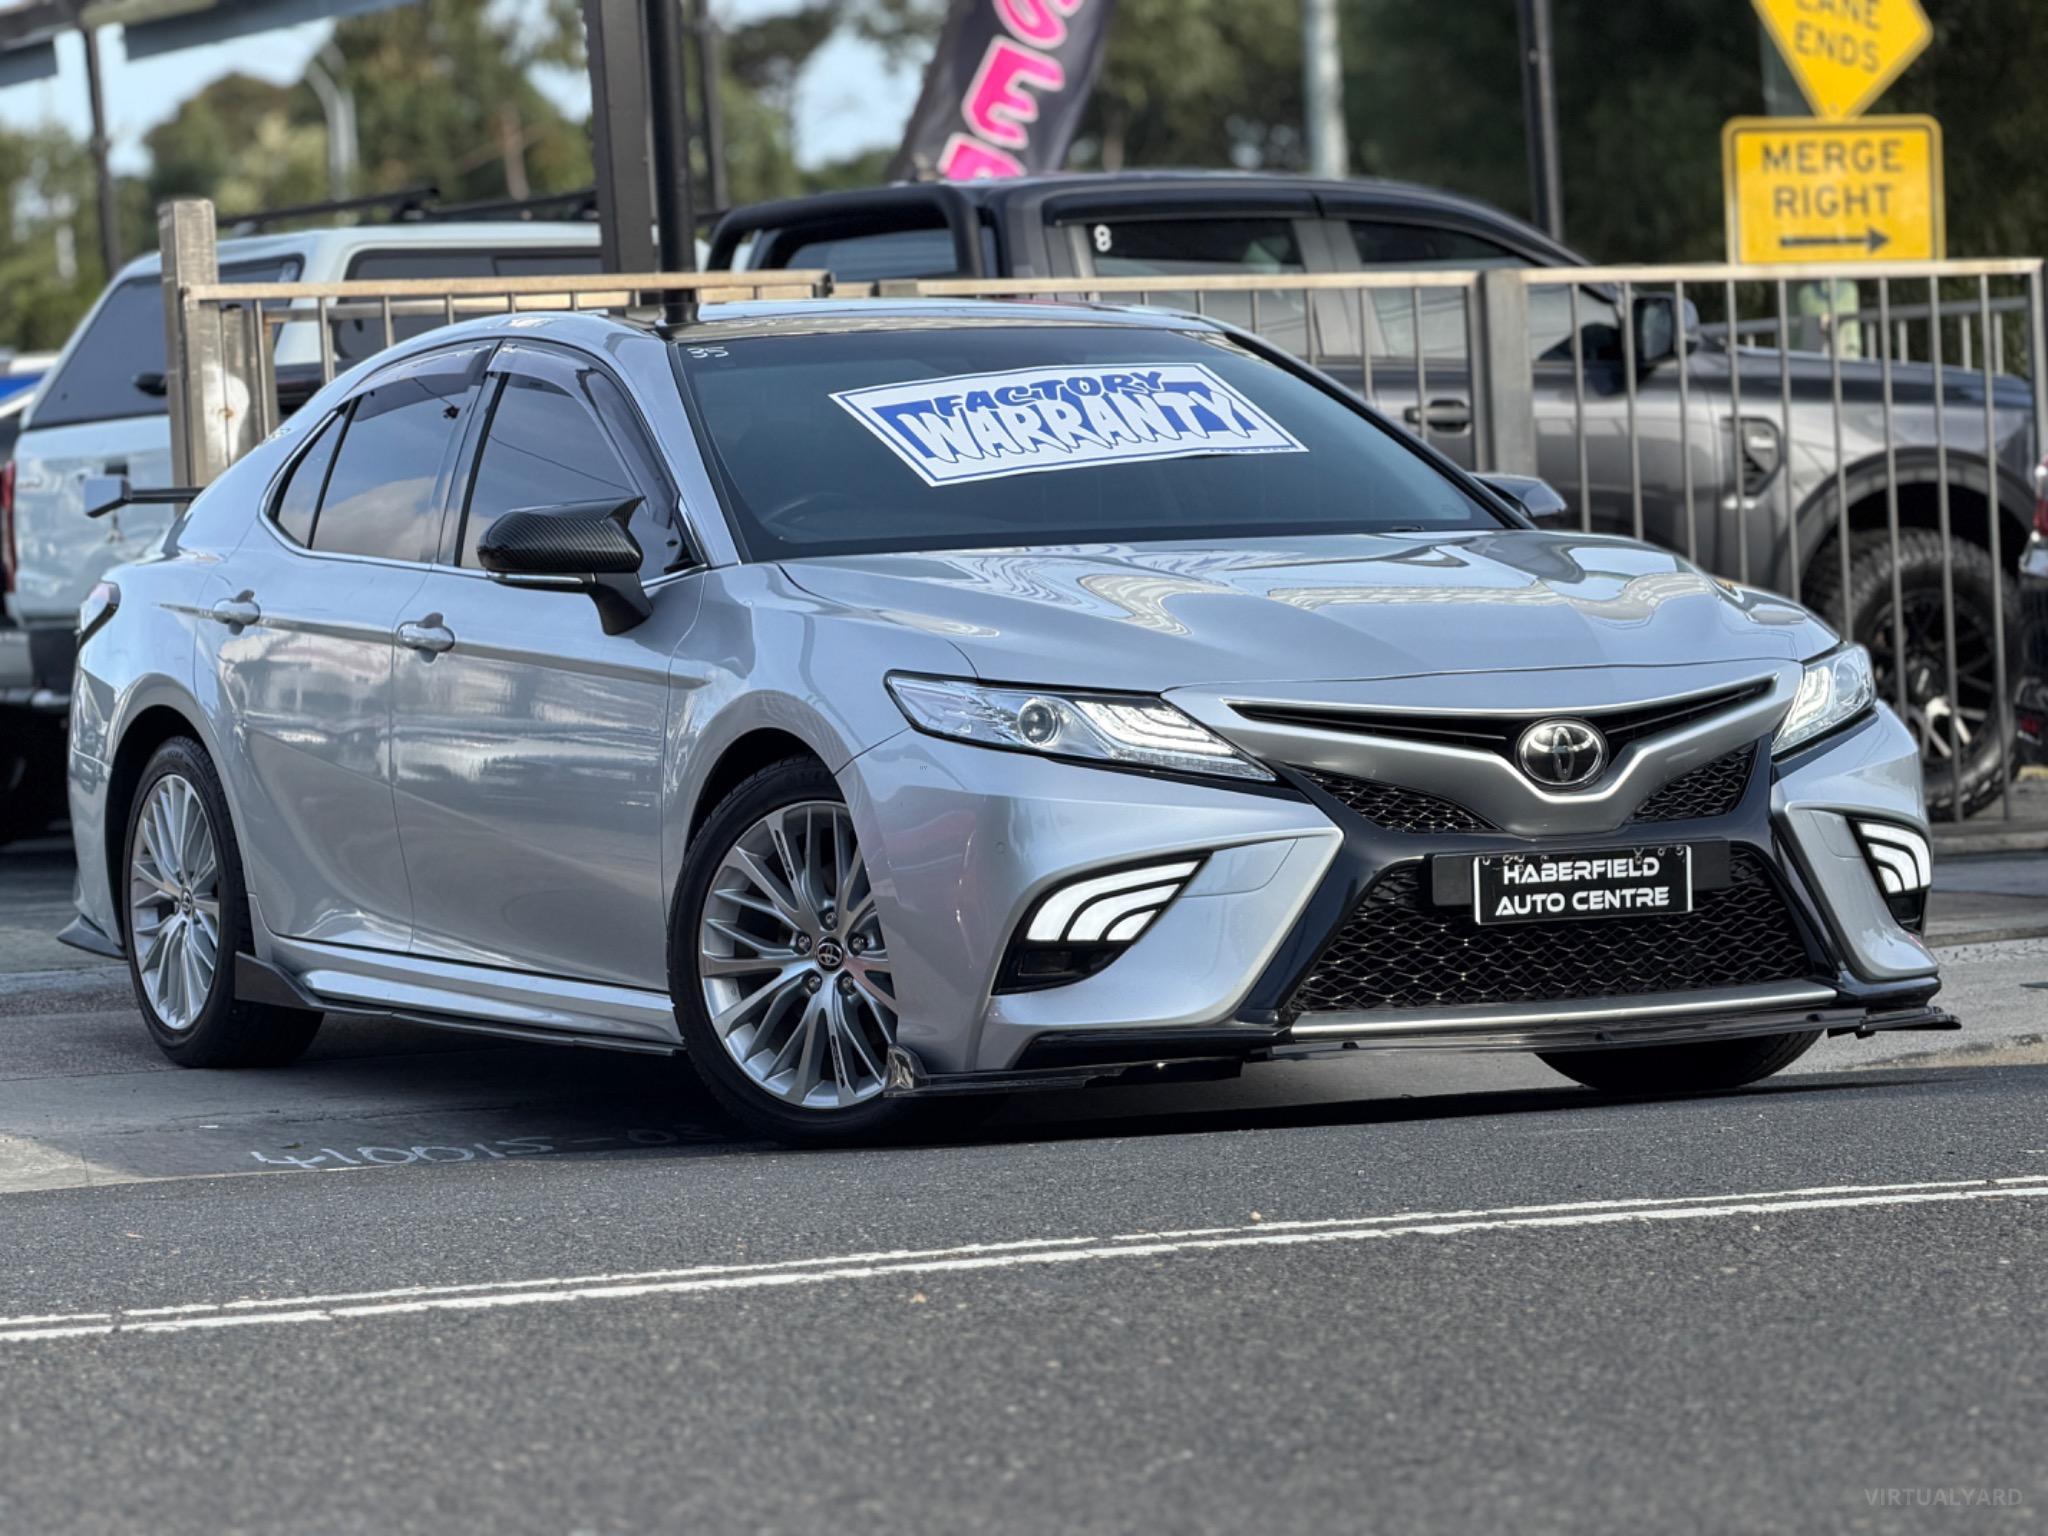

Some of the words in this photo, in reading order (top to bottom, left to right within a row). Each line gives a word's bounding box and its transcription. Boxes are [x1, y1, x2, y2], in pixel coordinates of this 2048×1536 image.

[1794, 20, 1881, 73] ENDS
[1760, 139, 1905, 174] MERGE
[1773, 185, 1892, 218] RIGHT
[1094, 224, 1112, 252] 8
[687, 346, 729, 358] 35
[934, 371, 1163, 418] FACTORY
[897, 390, 1251, 464] WARRANTY
[1503, 857, 1660, 885] HABERFIELD
[1495, 893, 1566, 916] AUTO
[1572, 886, 1670, 910] CENTRE
